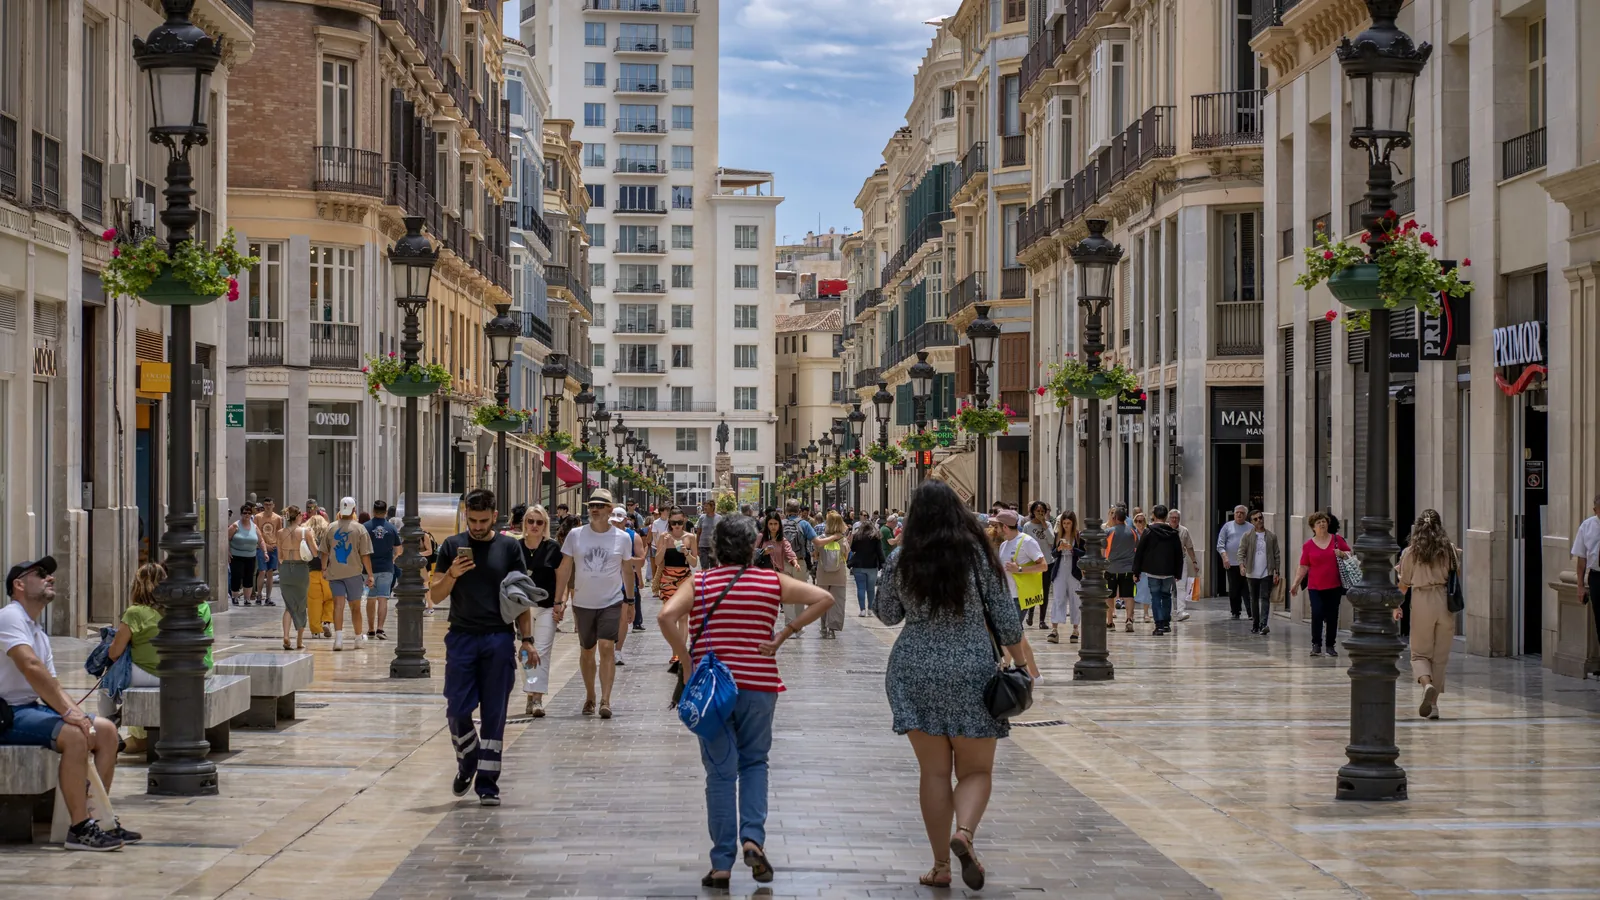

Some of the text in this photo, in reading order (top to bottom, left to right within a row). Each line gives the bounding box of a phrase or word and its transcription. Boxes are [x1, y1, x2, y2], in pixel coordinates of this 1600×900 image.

[1424, 290, 1441, 356] PRI
[1493, 320, 1543, 367] PRIMOR
[316, 412, 350, 425] OYSHO
[1221, 411, 1264, 426] MAN
